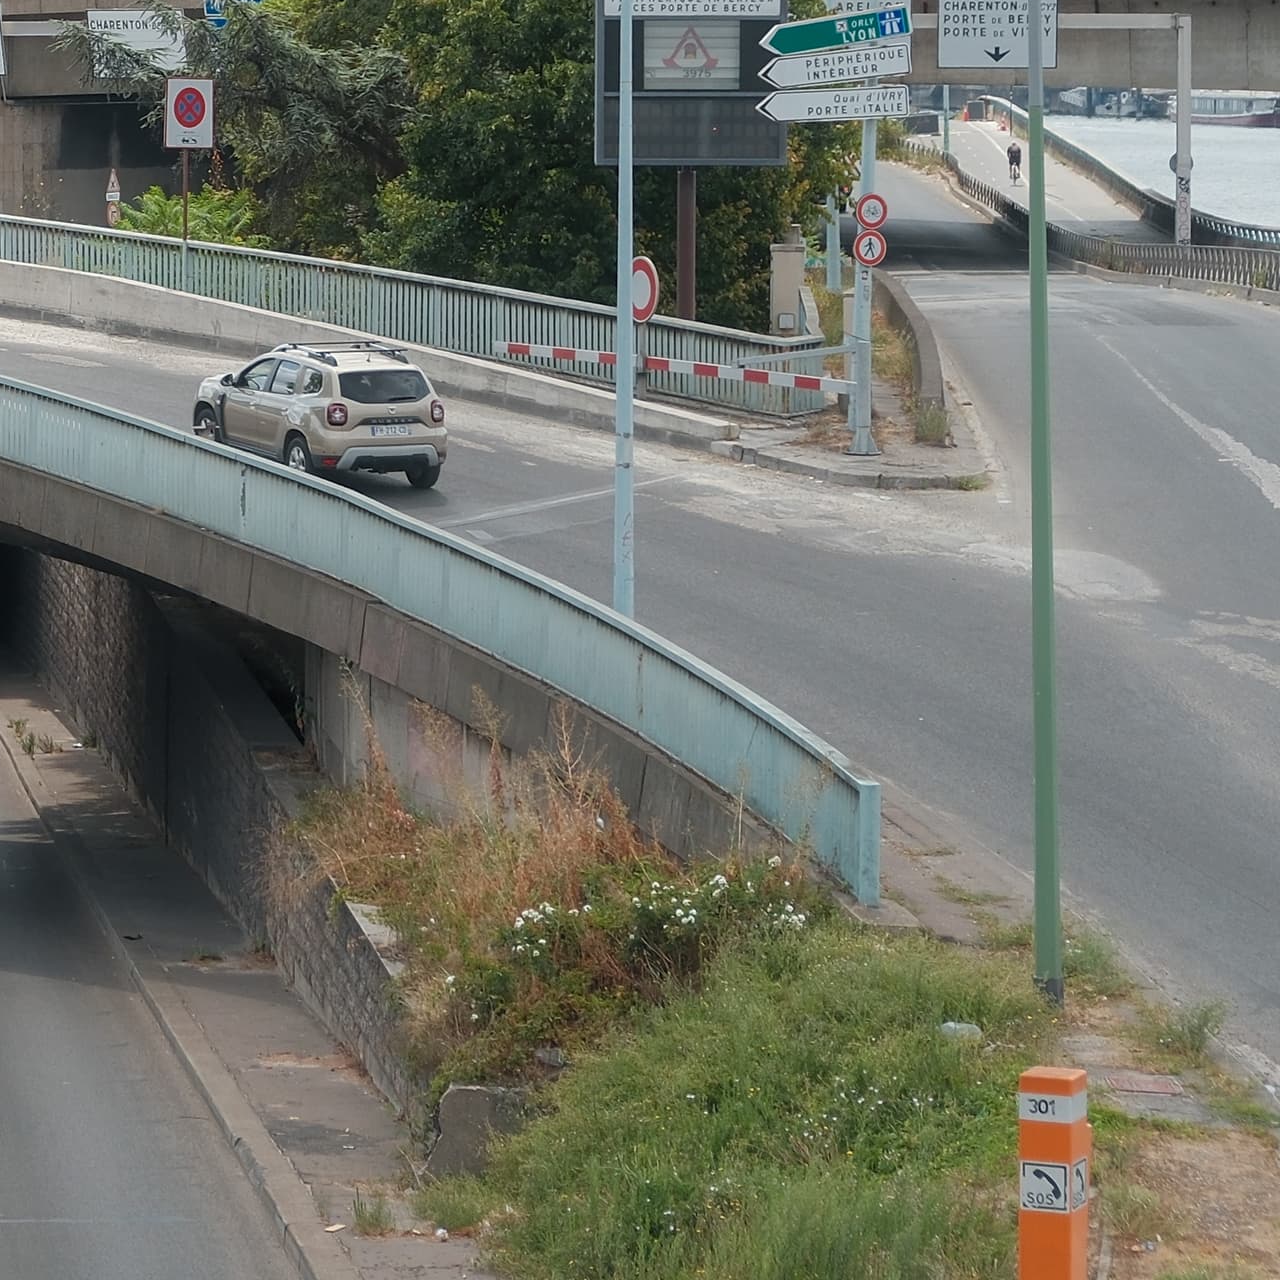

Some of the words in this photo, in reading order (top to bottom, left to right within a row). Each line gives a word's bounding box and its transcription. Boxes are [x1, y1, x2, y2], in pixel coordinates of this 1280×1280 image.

[660, 3, 698, 12] PORTE
[703, 3, 714, 12] DE
[723, 3, 762, 12] BERCY
[851, 17, 875, 29] ORLY
[943, 14, 986, 24] PORTE
[1008, 14, 1052, 24] BEY
[842, 27, 877, 43] LYON
[943, 27, 987, 37] PORTE
[1011, 27, 1052, 37] VIY
[833, 93, 860, 104] Quai
[866, 91, 904, 102] d'IVRY
[807, 105, 848, 116] PORTE
[1027, 1098, 1056, 1116] 301
[1026, 1191, 1055, 1206] SOS
